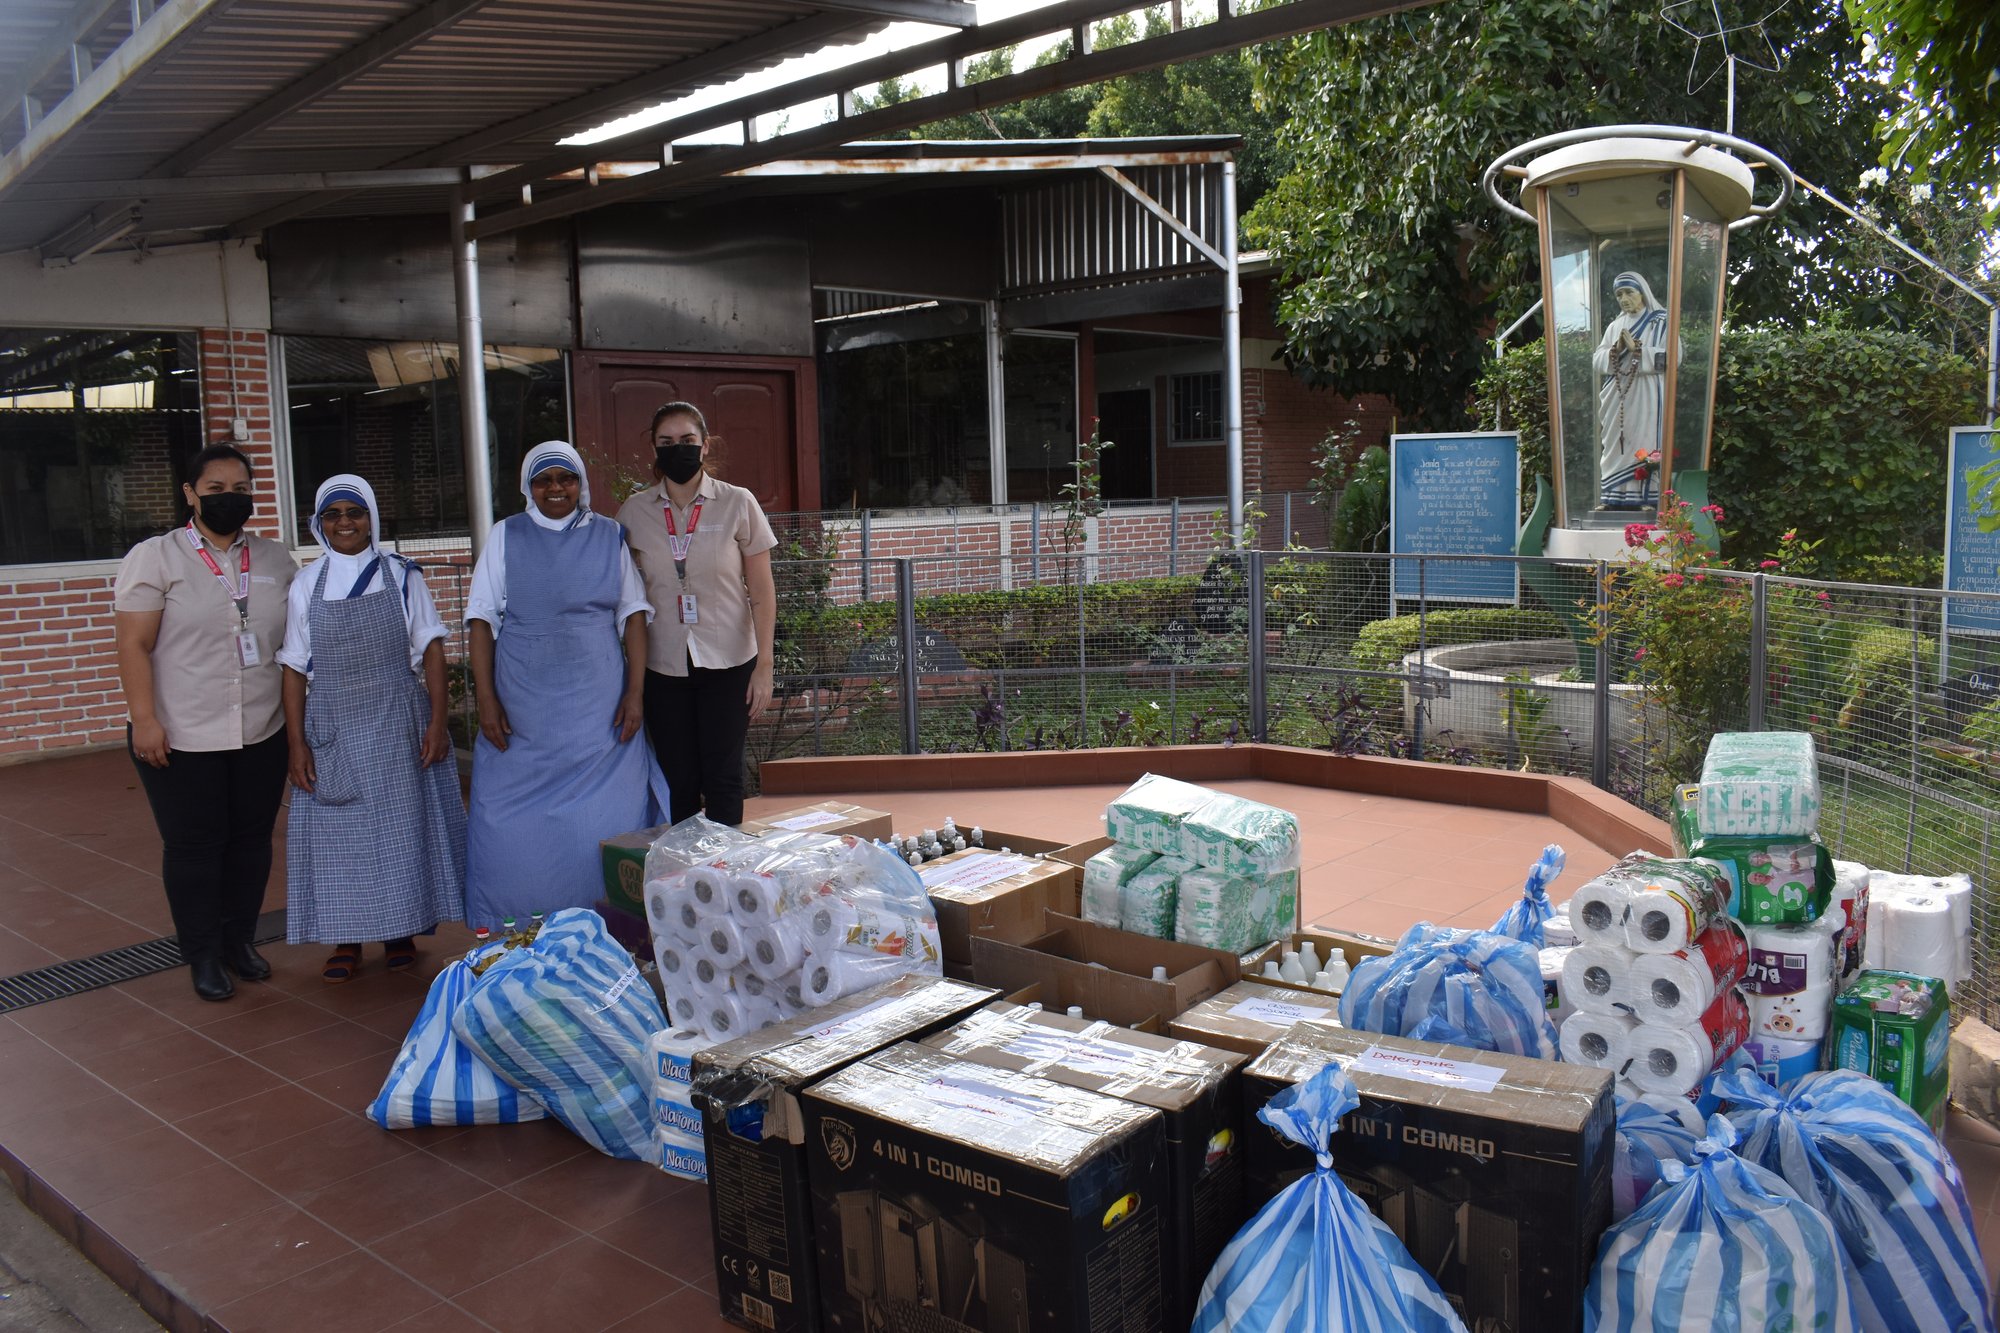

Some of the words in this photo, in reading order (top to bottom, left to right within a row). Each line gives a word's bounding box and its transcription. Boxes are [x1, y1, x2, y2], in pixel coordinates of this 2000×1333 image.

[1466, 458, 1474, 467] de
[1248, 1005, 1305, 1018] personal
[1267, 1002, 1301, 1011] aseo
[1371, 1051, 1456, 1069] Detergente
[1351, 1116, 1376, 1137] IN
[1384, 1122, 1393, 1140] 1
[1402, 1125, 1495, 1159] COMBO
[873, 1139, 883, 1156] 4
[887, 1143, 907, 1165] IN
[913, 1151, 920, 1169] 1
[927, 1155, 1001, 1196] COMBO
